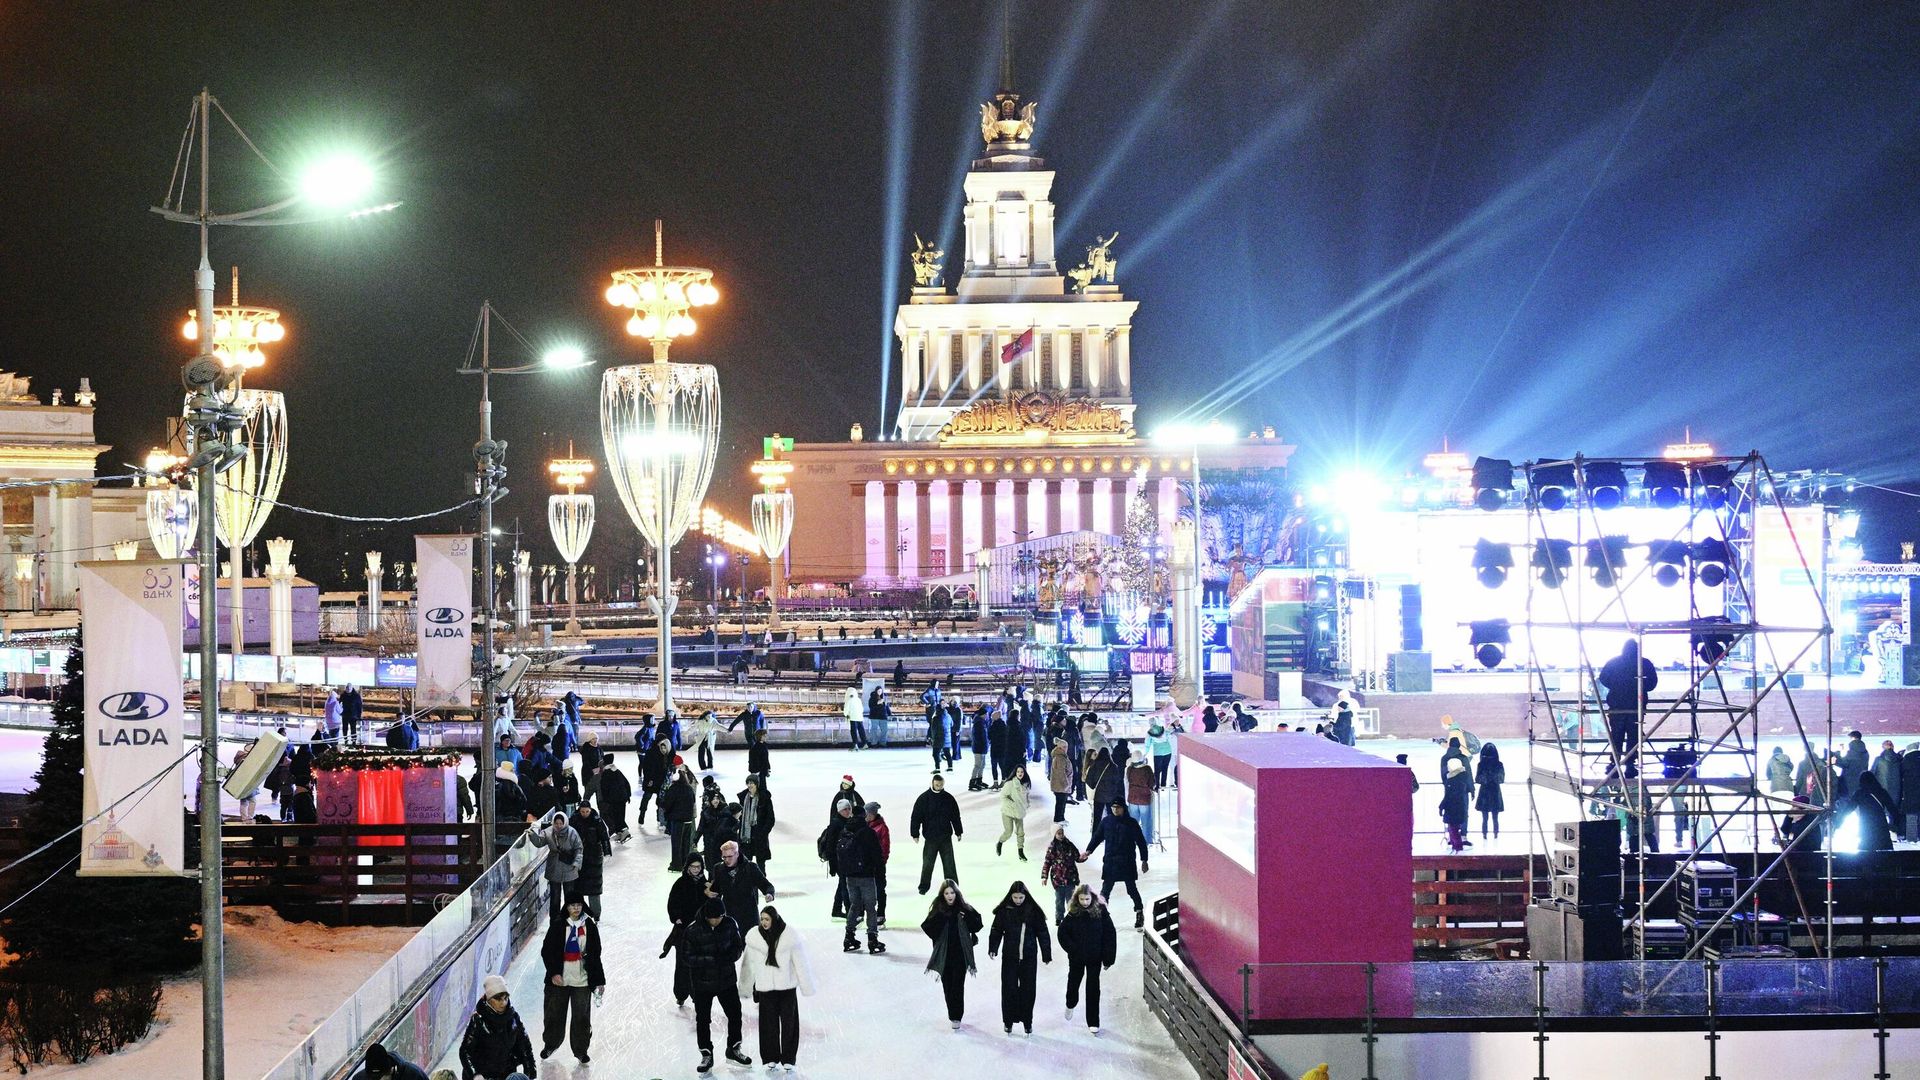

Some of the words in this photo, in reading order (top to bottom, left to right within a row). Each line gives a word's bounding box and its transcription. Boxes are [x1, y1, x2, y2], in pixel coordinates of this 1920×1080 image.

[143, 568, 172, 589] 85
[143, 591, 172, 599] ВДНХ
[425, 628, 464, 638] LADA
[98, 728, 169, 746] LADA
